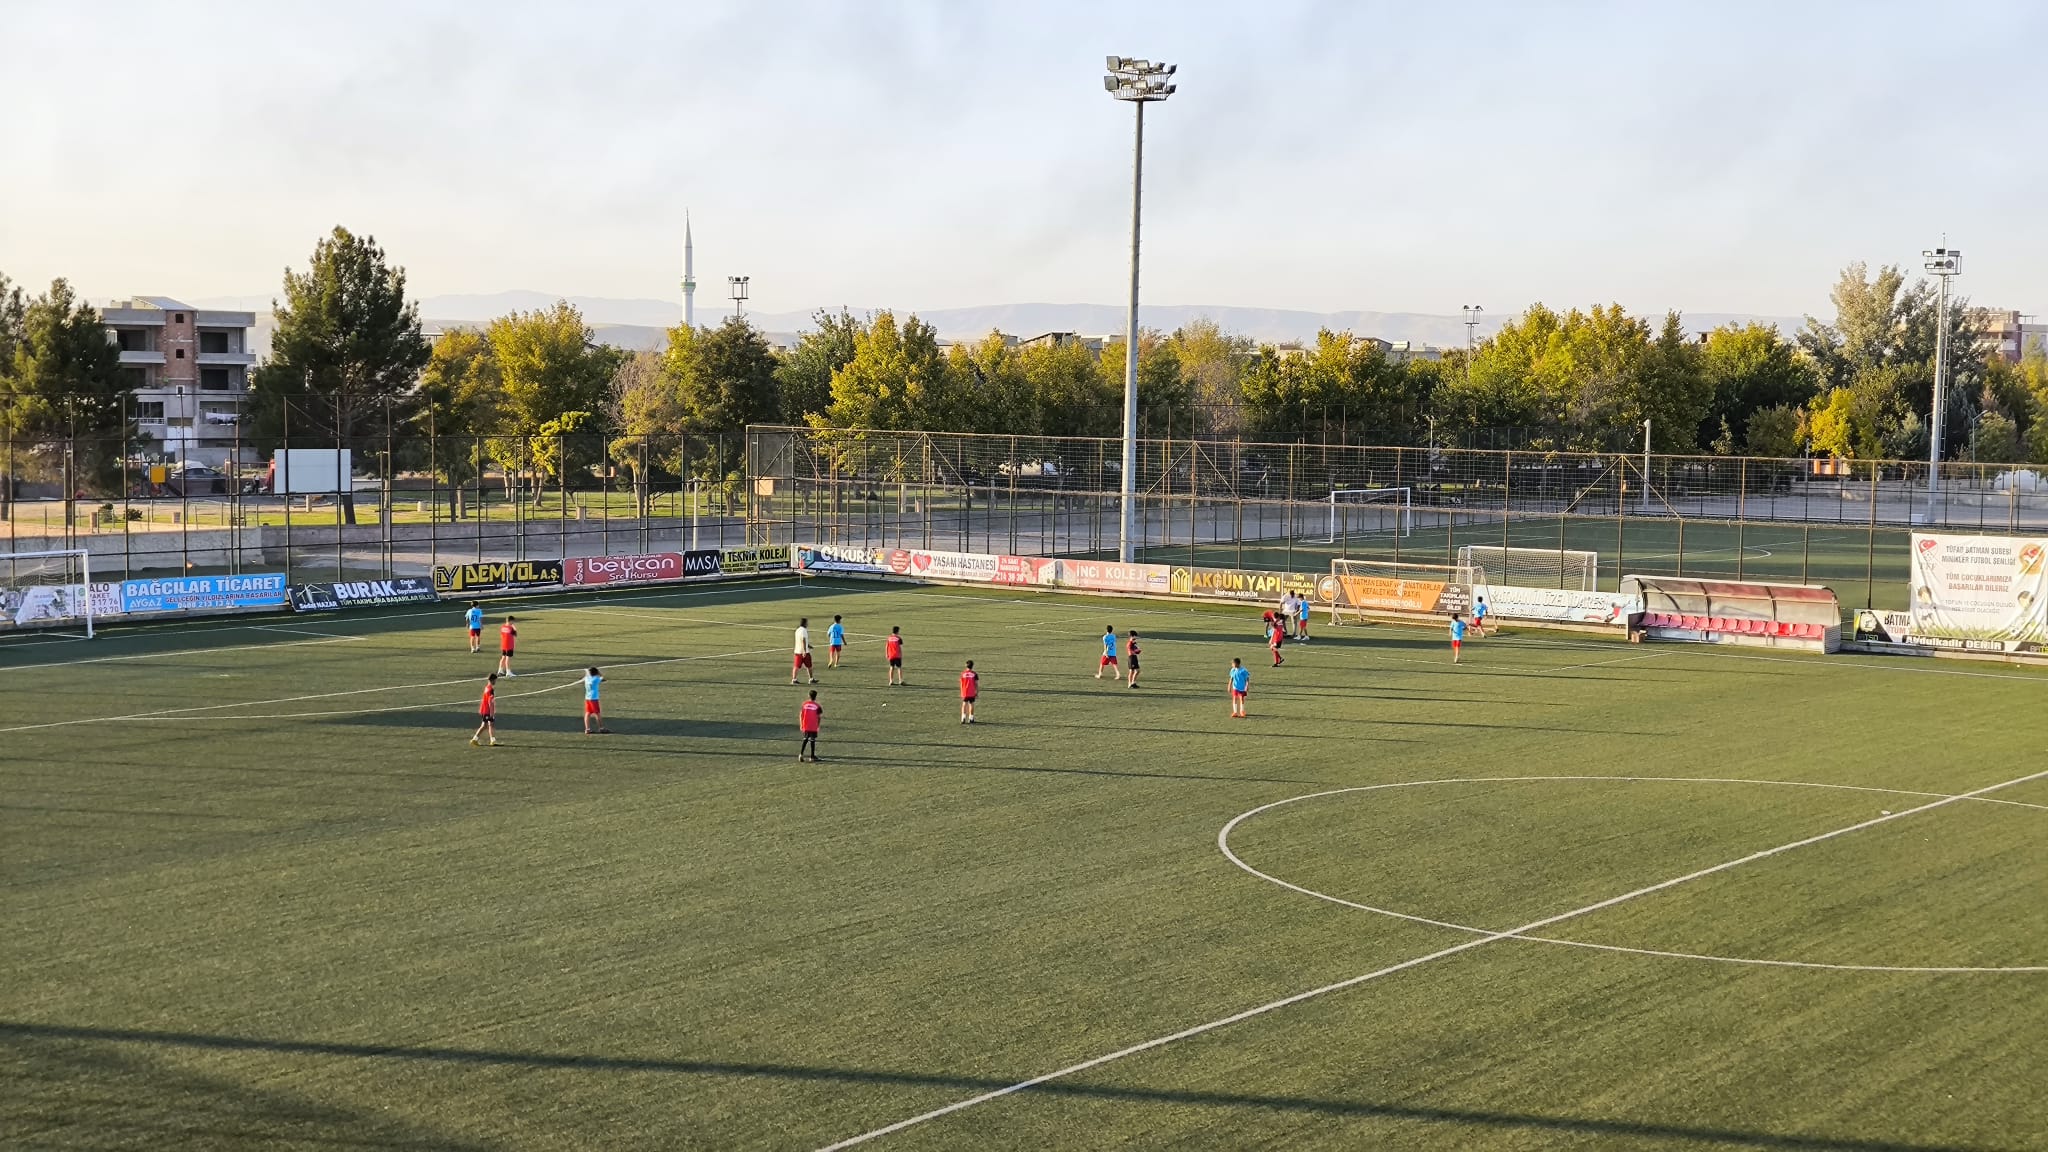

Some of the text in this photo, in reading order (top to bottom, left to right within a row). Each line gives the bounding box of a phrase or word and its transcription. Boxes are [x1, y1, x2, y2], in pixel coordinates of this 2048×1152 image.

[588, 558, 674, 578] beycan
[126, 574, 282, 597] BAĞCILAR TİCARET
[333, 580, 397, 599] BURAK
[1192, 570, 1280, 592] AKGÜN YAPI
[129, 597, 162, 608] AYGAZ
